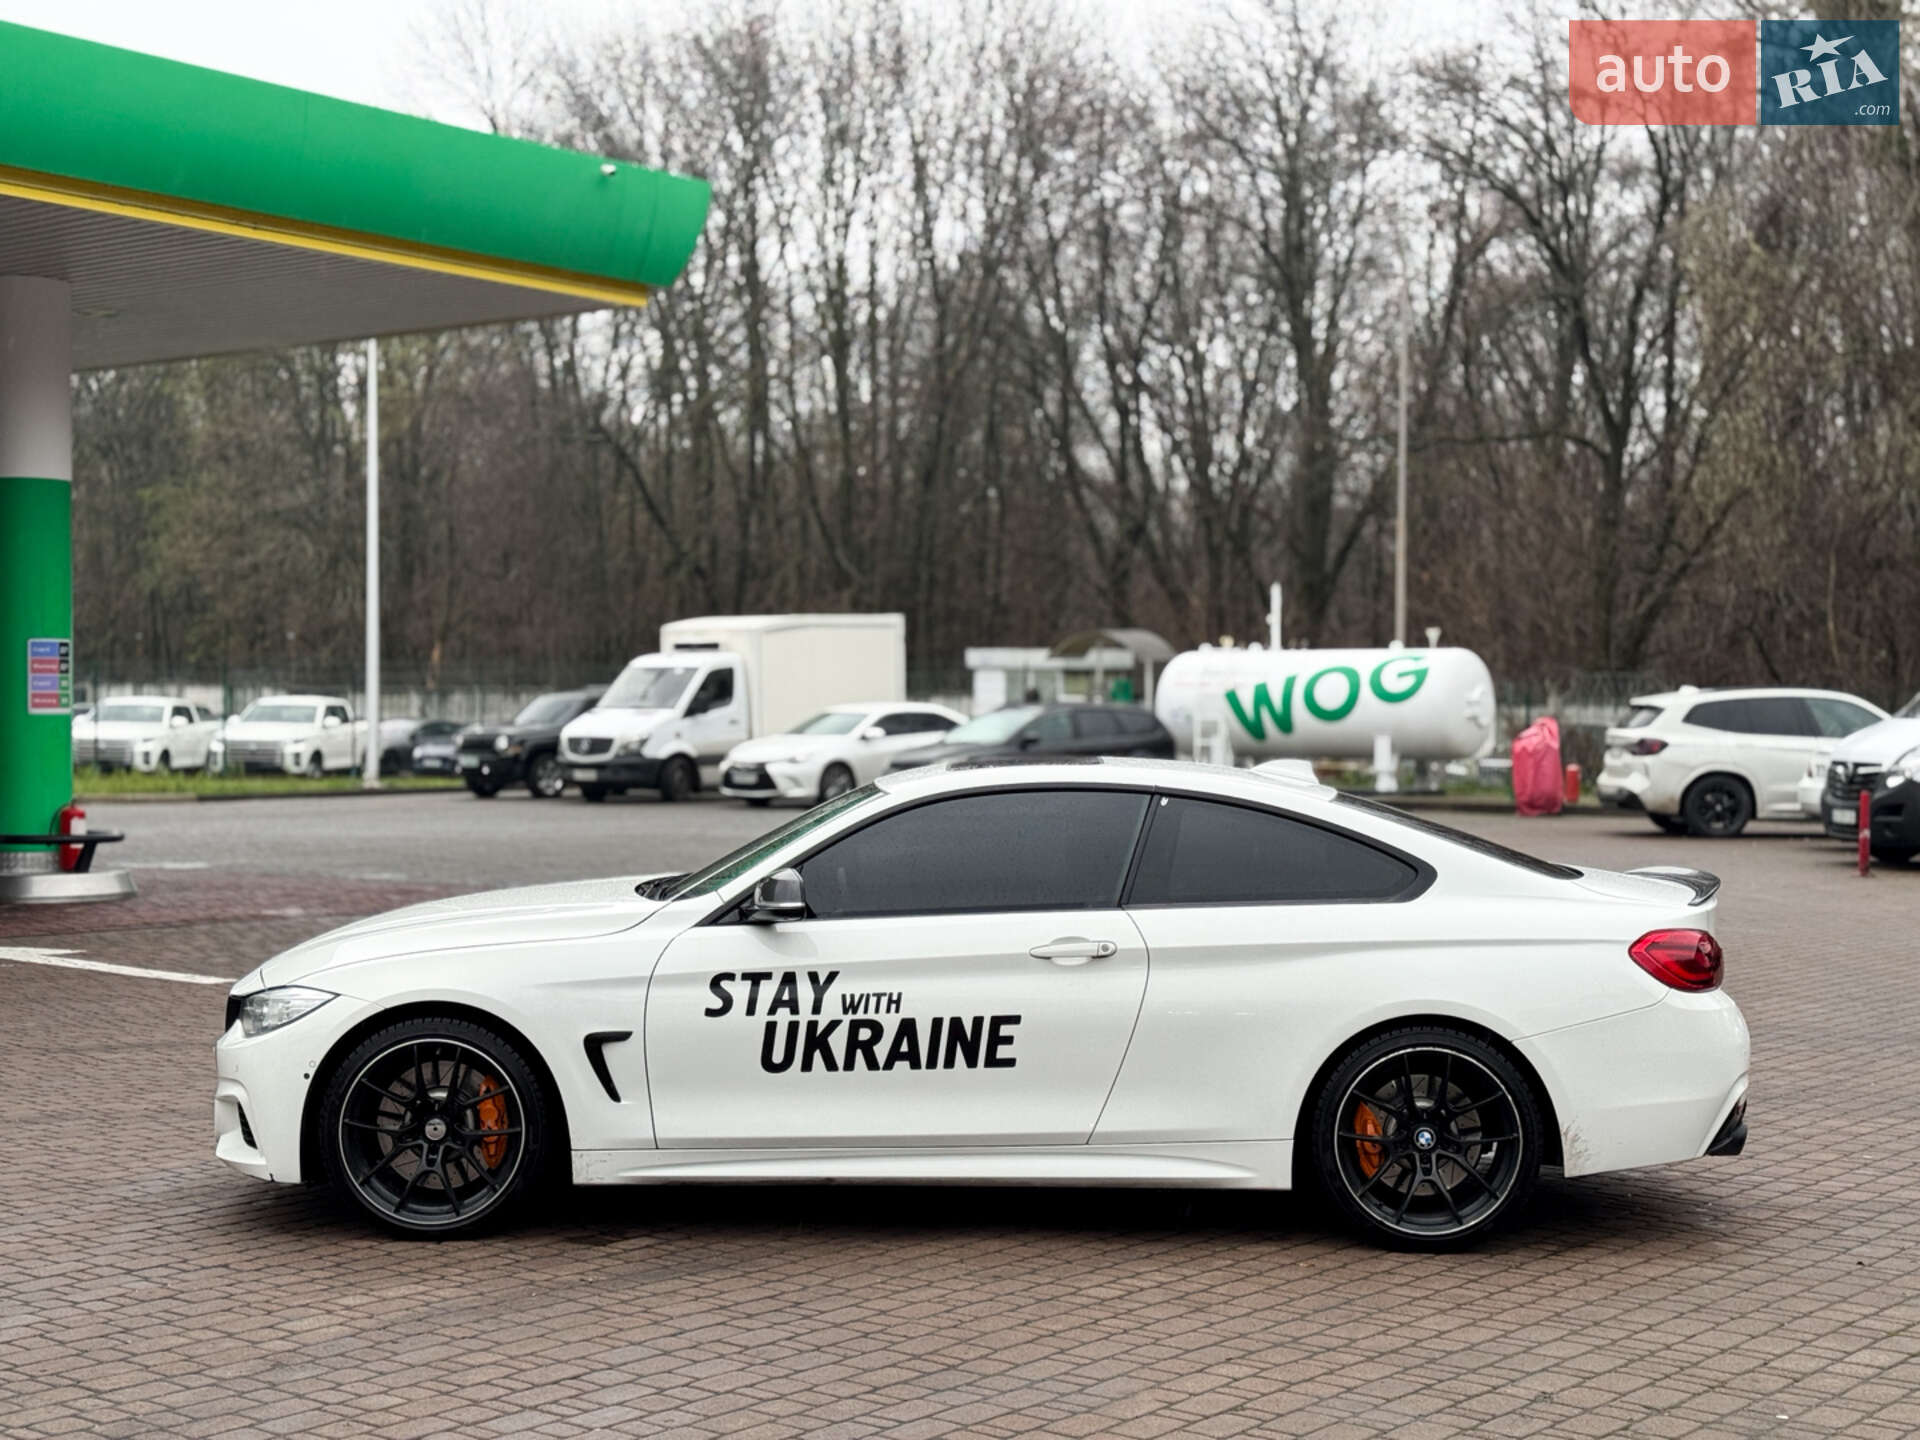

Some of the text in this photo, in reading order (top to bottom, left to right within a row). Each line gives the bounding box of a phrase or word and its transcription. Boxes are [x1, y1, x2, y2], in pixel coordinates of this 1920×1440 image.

[1225, 656, 1430, 741] WOG
[704, 970, 903, 1018] STAY WITH
[760, 1014, 1022, 1074] UKRAINE
